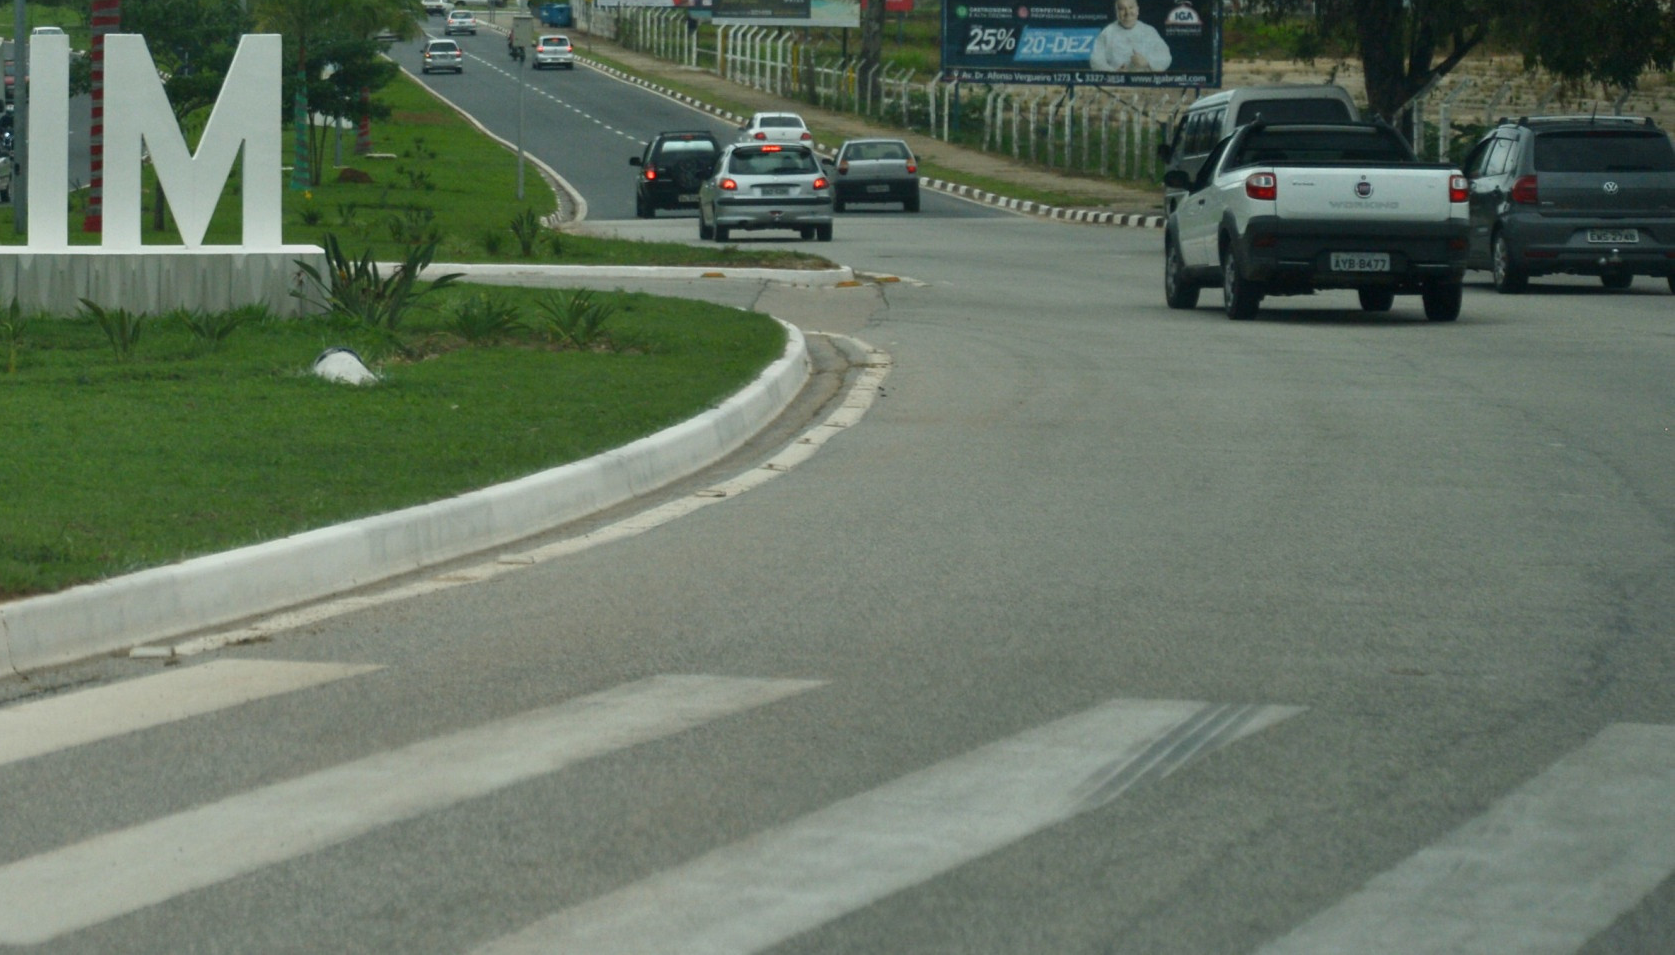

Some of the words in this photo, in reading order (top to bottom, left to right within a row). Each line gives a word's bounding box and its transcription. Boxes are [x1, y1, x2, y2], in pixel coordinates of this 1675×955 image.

[1174, 11, 1194, 21] IGA
[966, 28, 1016, 51] 25%
[1021, 35, 1095, 54] 20-DEZ
[1014, 72, 1052, 82] Vergueiro
[1053, 73, 1071, 82] 1273
[1328, 200, 1399, 210] WORKING
